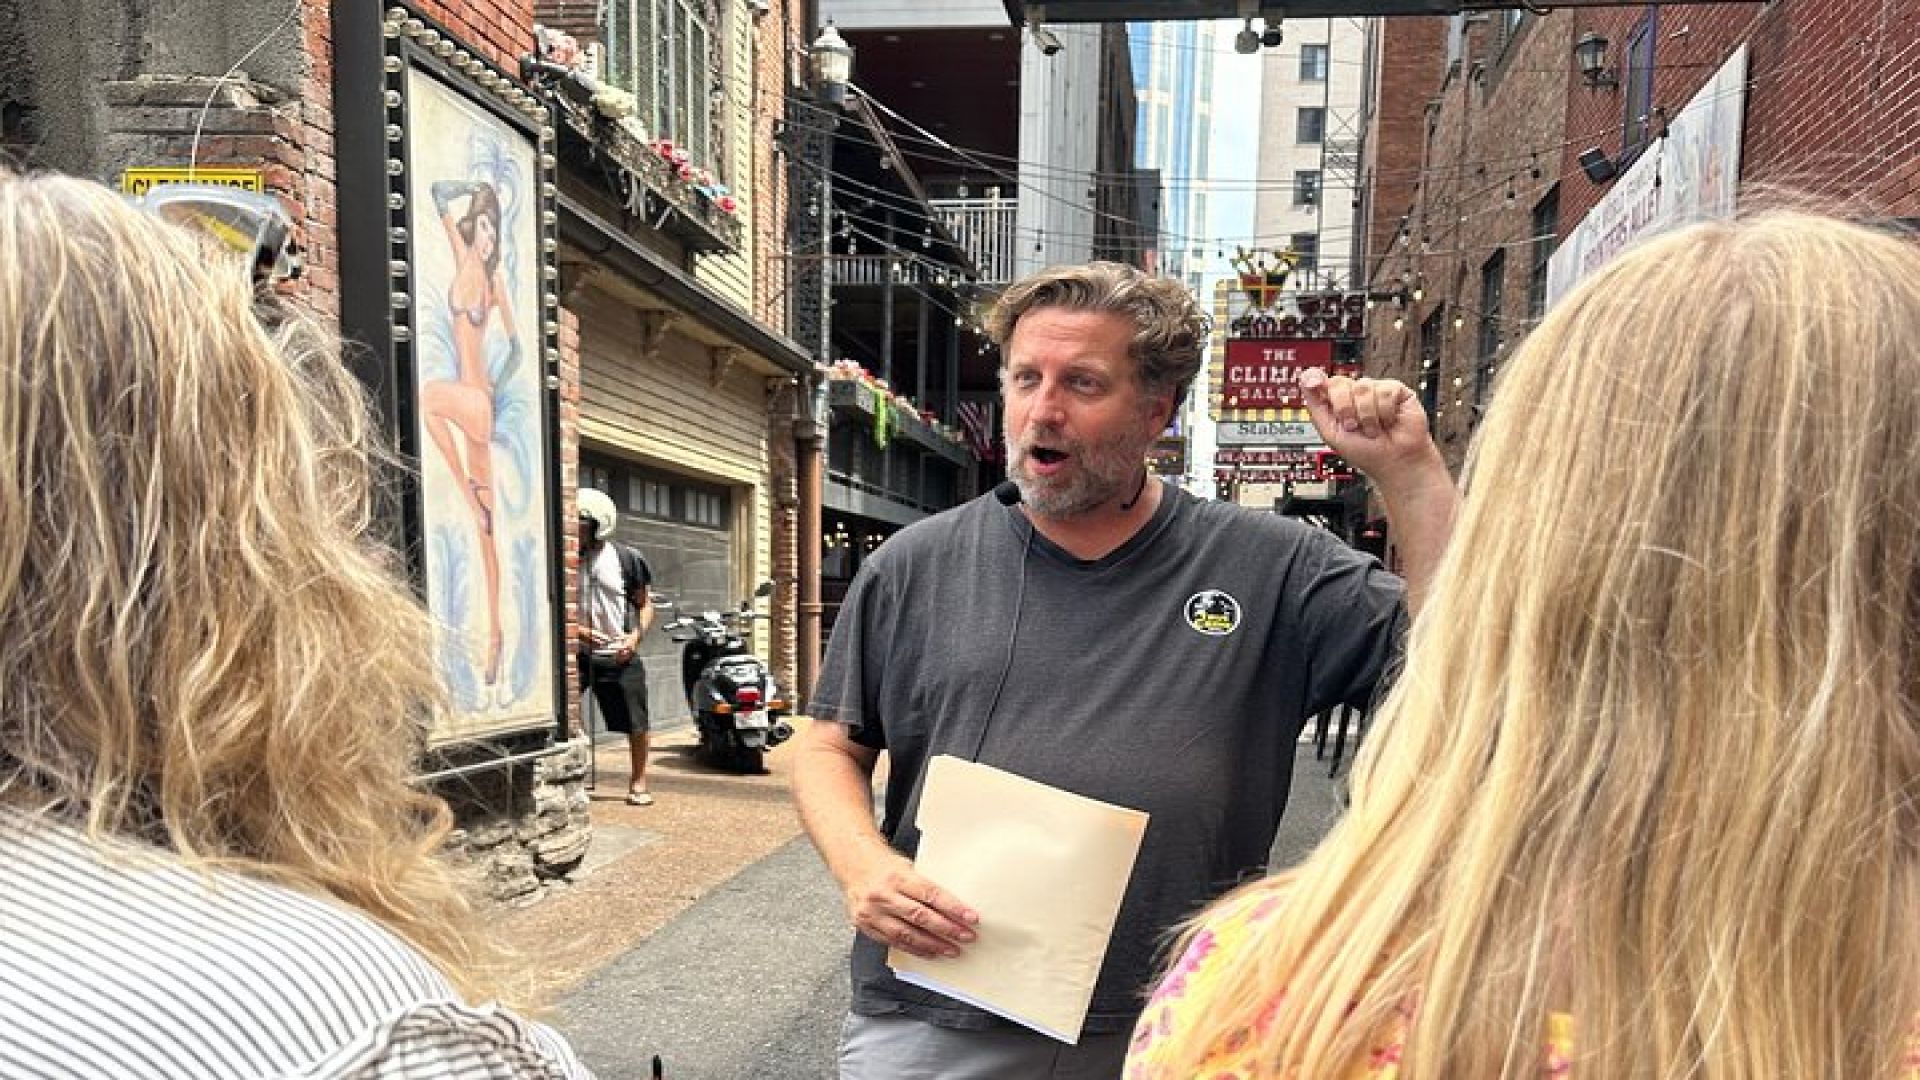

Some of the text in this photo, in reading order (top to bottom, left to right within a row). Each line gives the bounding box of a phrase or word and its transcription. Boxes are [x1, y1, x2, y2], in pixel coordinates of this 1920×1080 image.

[1263, 348, 1297, 361] THE
[1230, 365, 1325, 384] CLIMA
[1237, 422, 1305, 435] Stables
